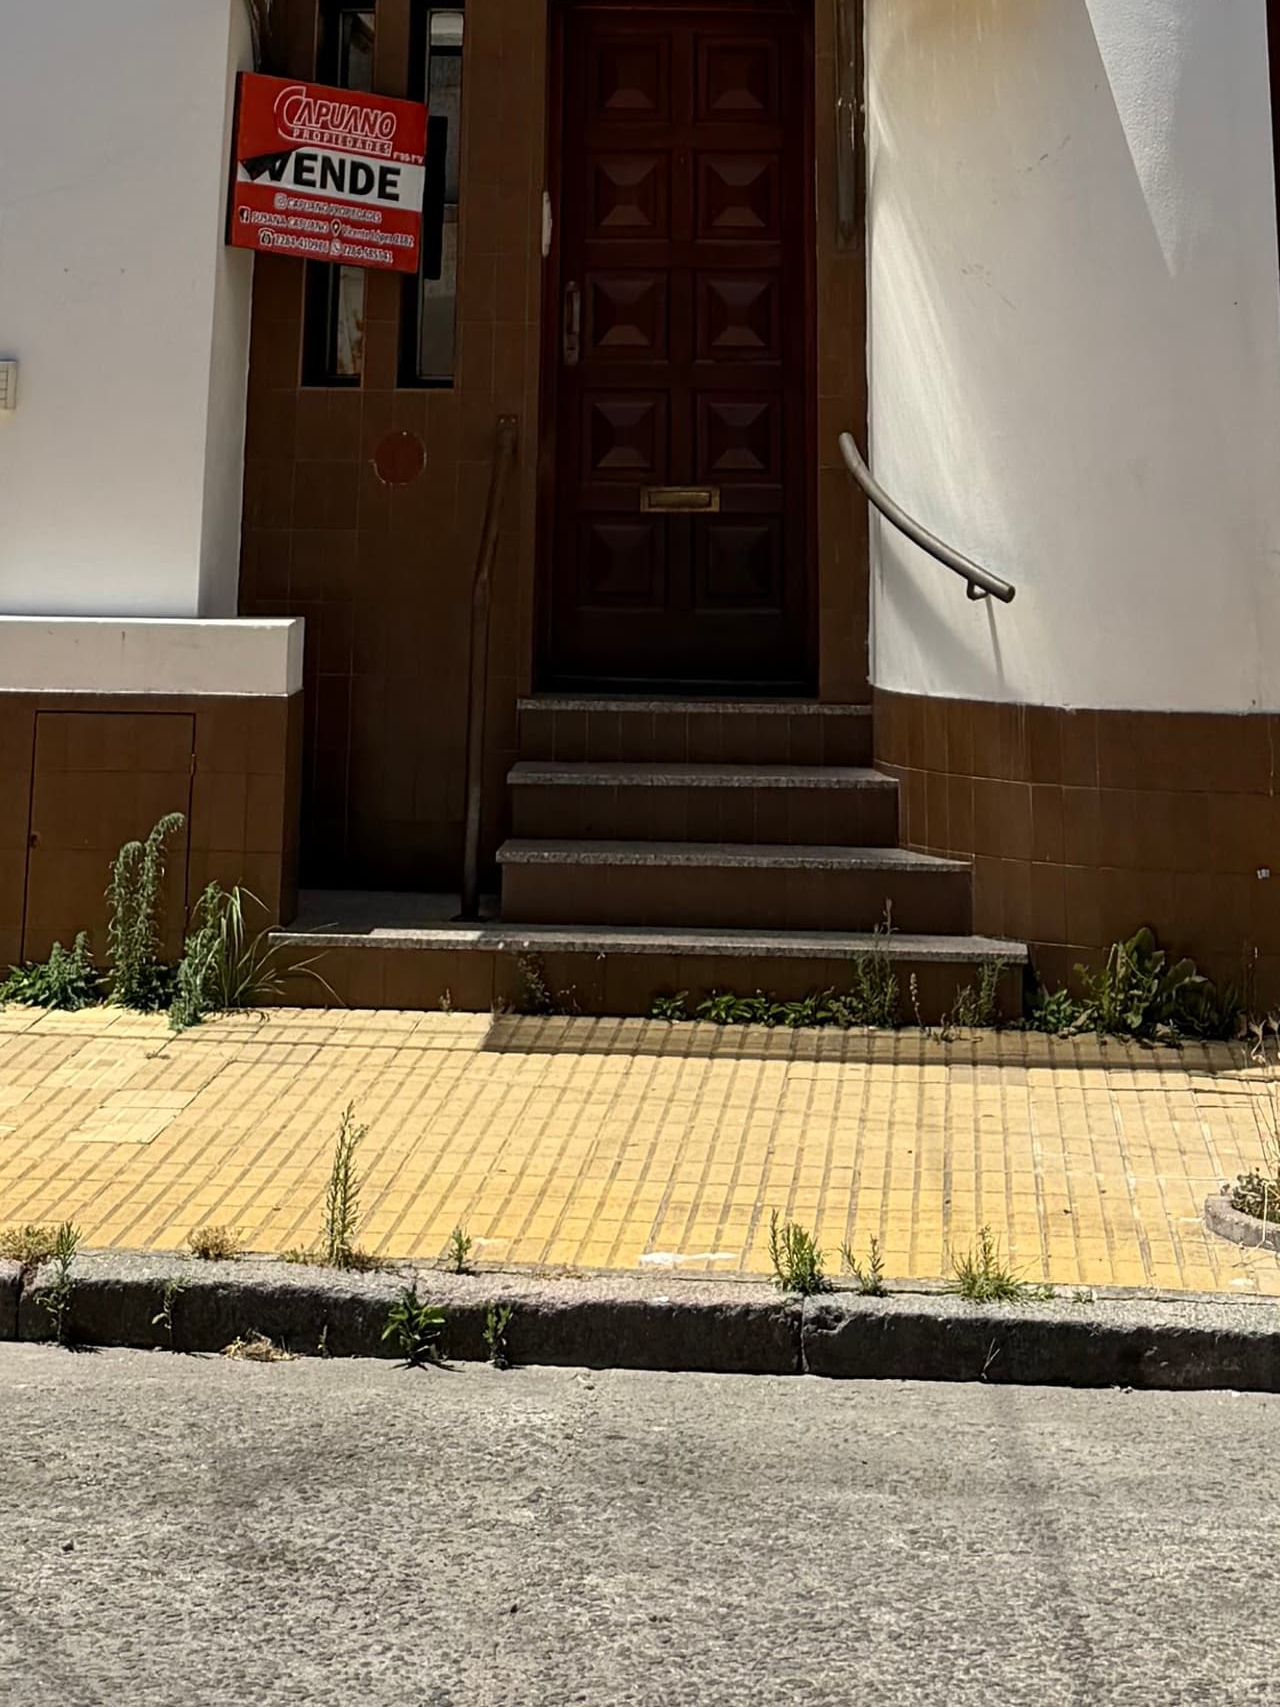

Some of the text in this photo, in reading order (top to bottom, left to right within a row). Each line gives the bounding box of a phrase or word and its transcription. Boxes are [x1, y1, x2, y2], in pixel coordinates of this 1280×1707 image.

[274, 85, 397, 140] CAPUANO
[293, 126, 391, 154] PROPIEDADES
[288, 216, 329, 233] CAPUANO
